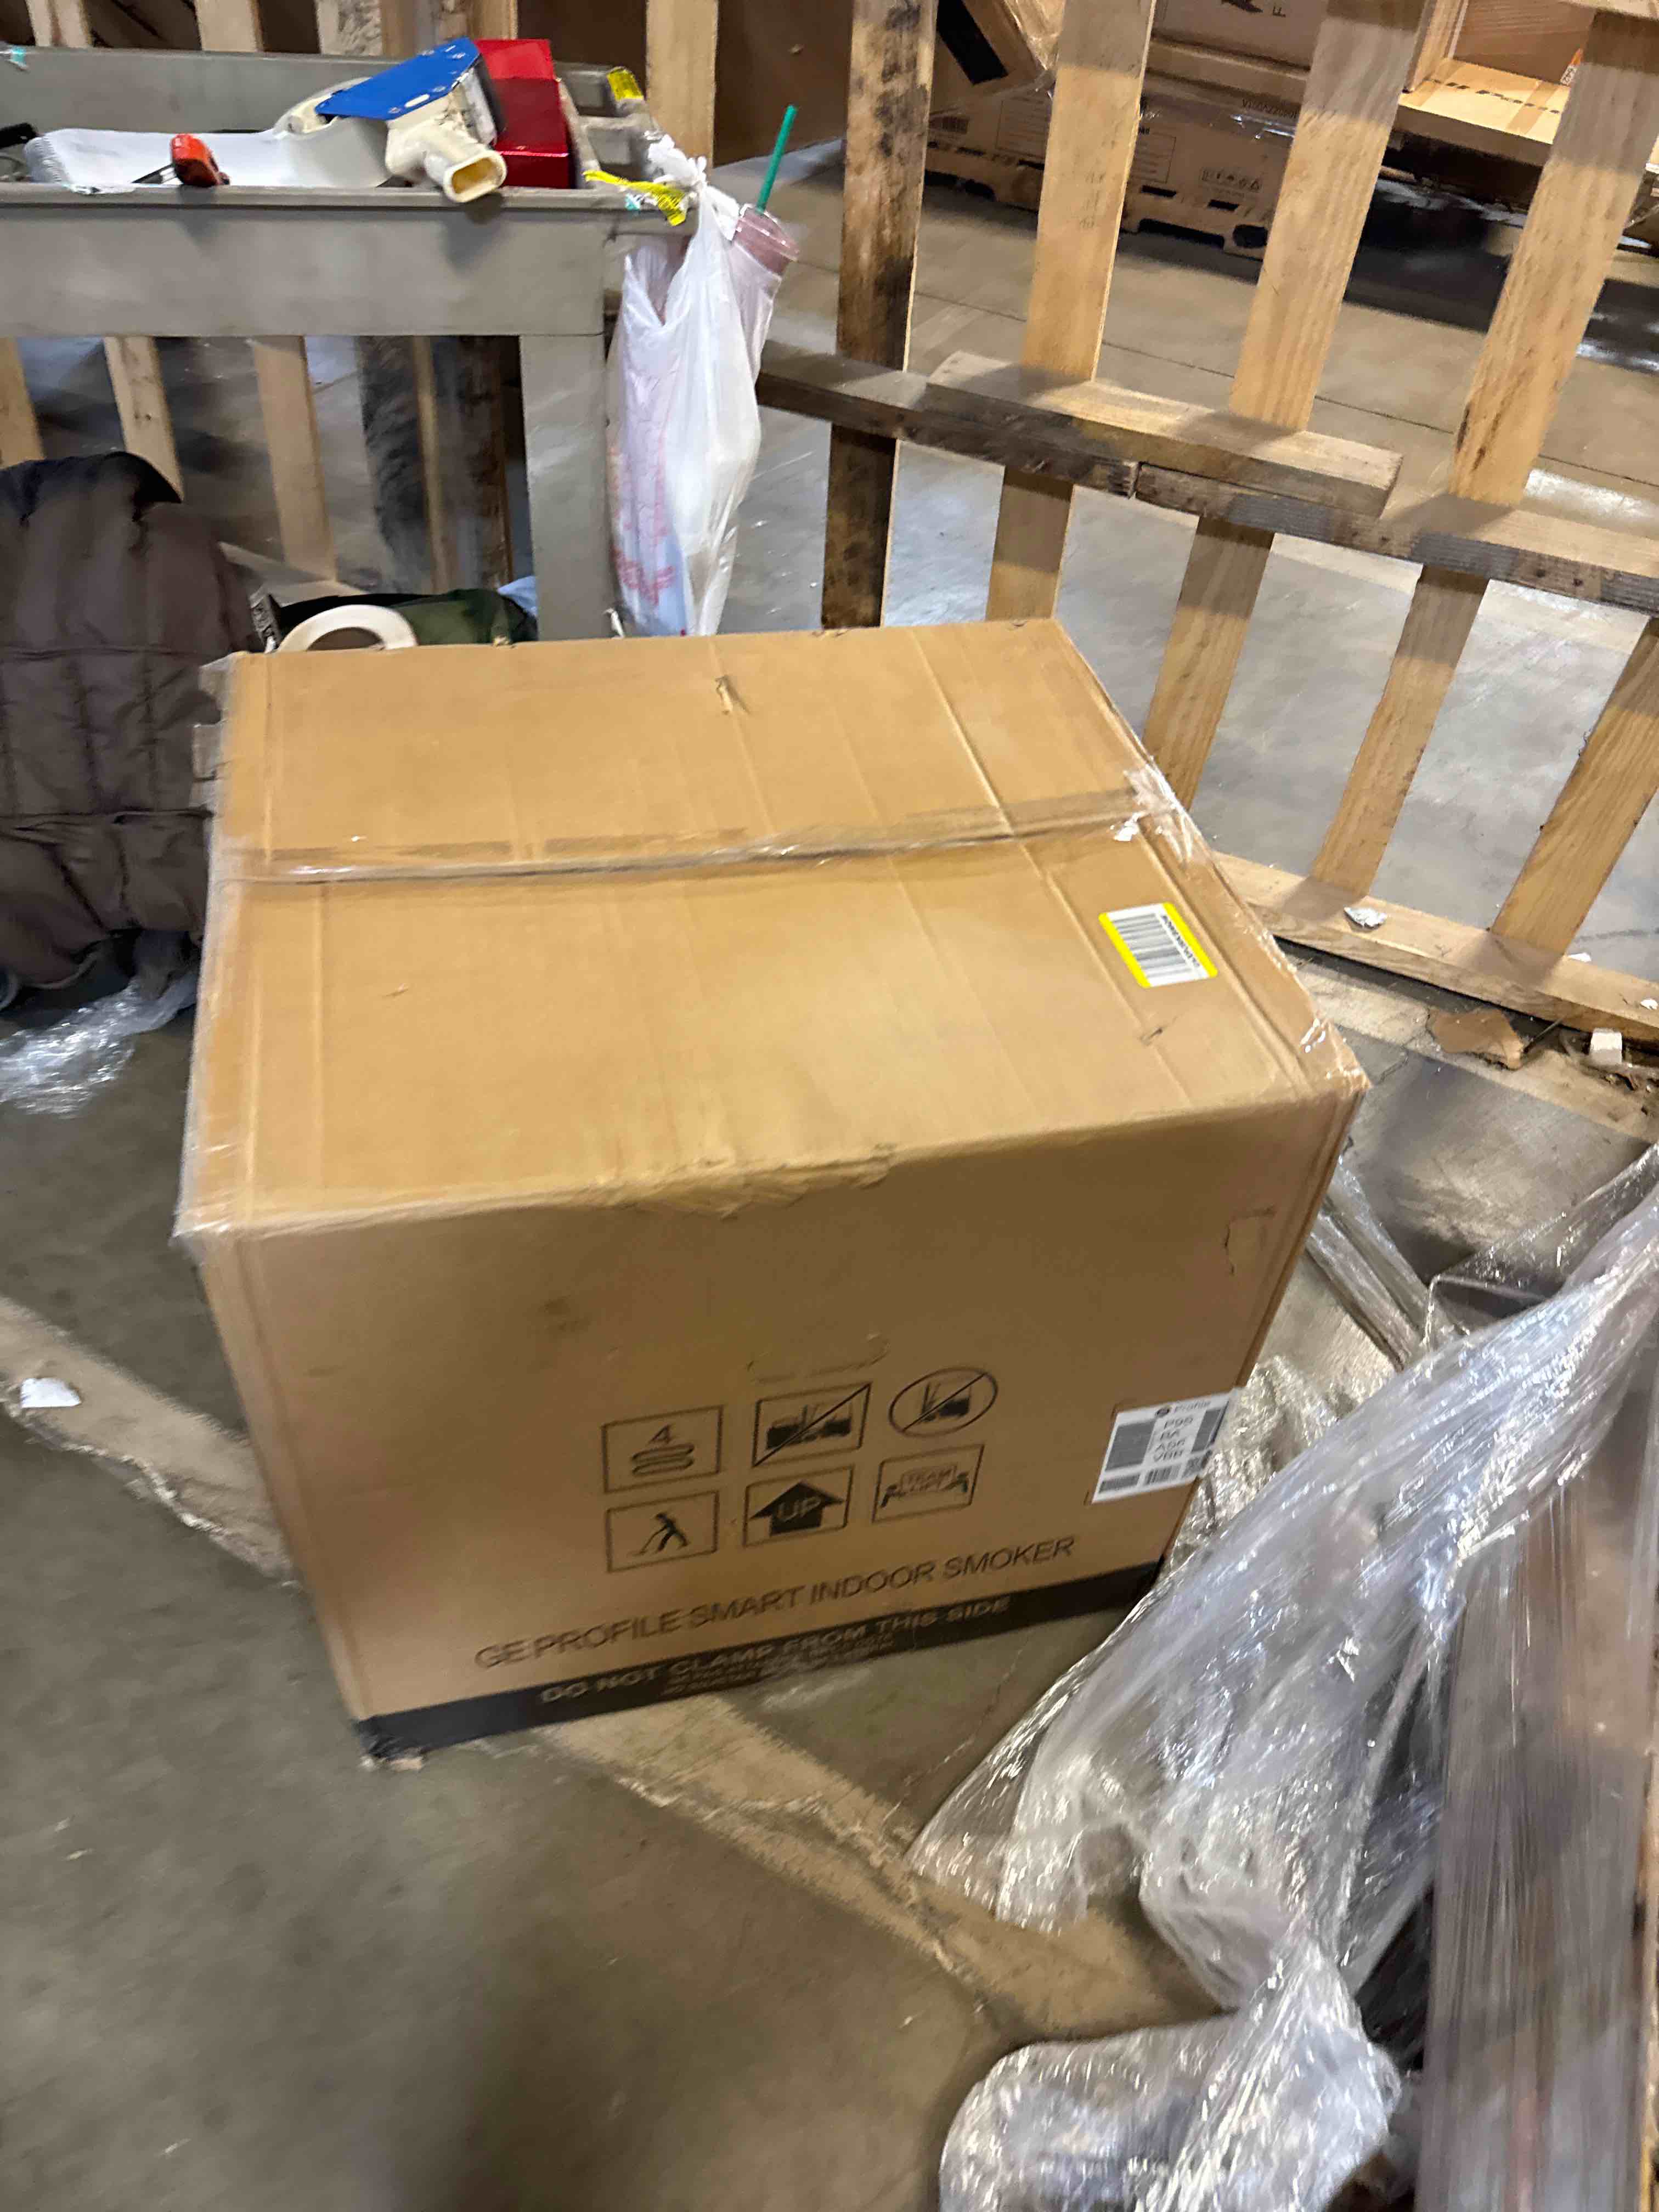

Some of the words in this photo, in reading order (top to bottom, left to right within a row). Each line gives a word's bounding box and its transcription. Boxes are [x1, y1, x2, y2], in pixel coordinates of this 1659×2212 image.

[648, 1424, 672, 1444] 4
[777, 1495, 822, 1522] UP
[475, 1637, 526, 1668] GE
[533, 1609, 685, 1659] PROFILE
[686, 1584, 807, 1630] SMART
[809, 1560, 937, 1605] INDOOR
[943, 1536, 1076, 1581] SMOKER
[539, 1680, 589, 1703] DO
[595, 1666, 661, 1692] NOT
[669, 1645, 772, 1676] CLAMP
[783, 1622, 868, 1652] FROM
[874, 1608, 939, 1635] THIS
[946, 1594, 1012, 1622] SIDE
